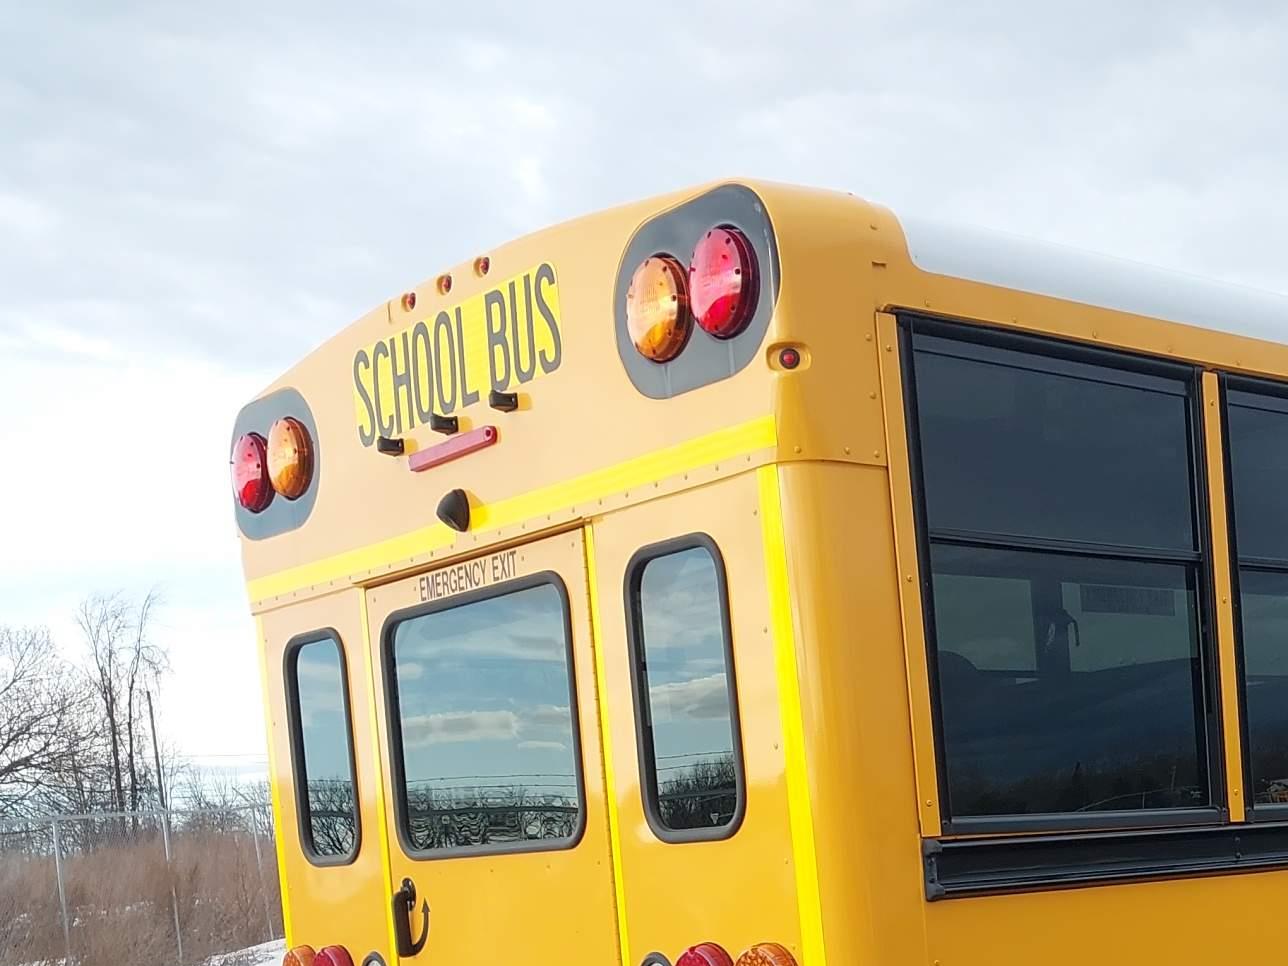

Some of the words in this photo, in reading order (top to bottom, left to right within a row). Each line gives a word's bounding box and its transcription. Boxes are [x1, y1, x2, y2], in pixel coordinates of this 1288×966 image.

[353, 306, 480, 447] SCHOOL
[484, 263, 562, 392] BUS
[419, 559, 487, 601] EMERGENCY
[491, 550, 517, 582] EXIT
